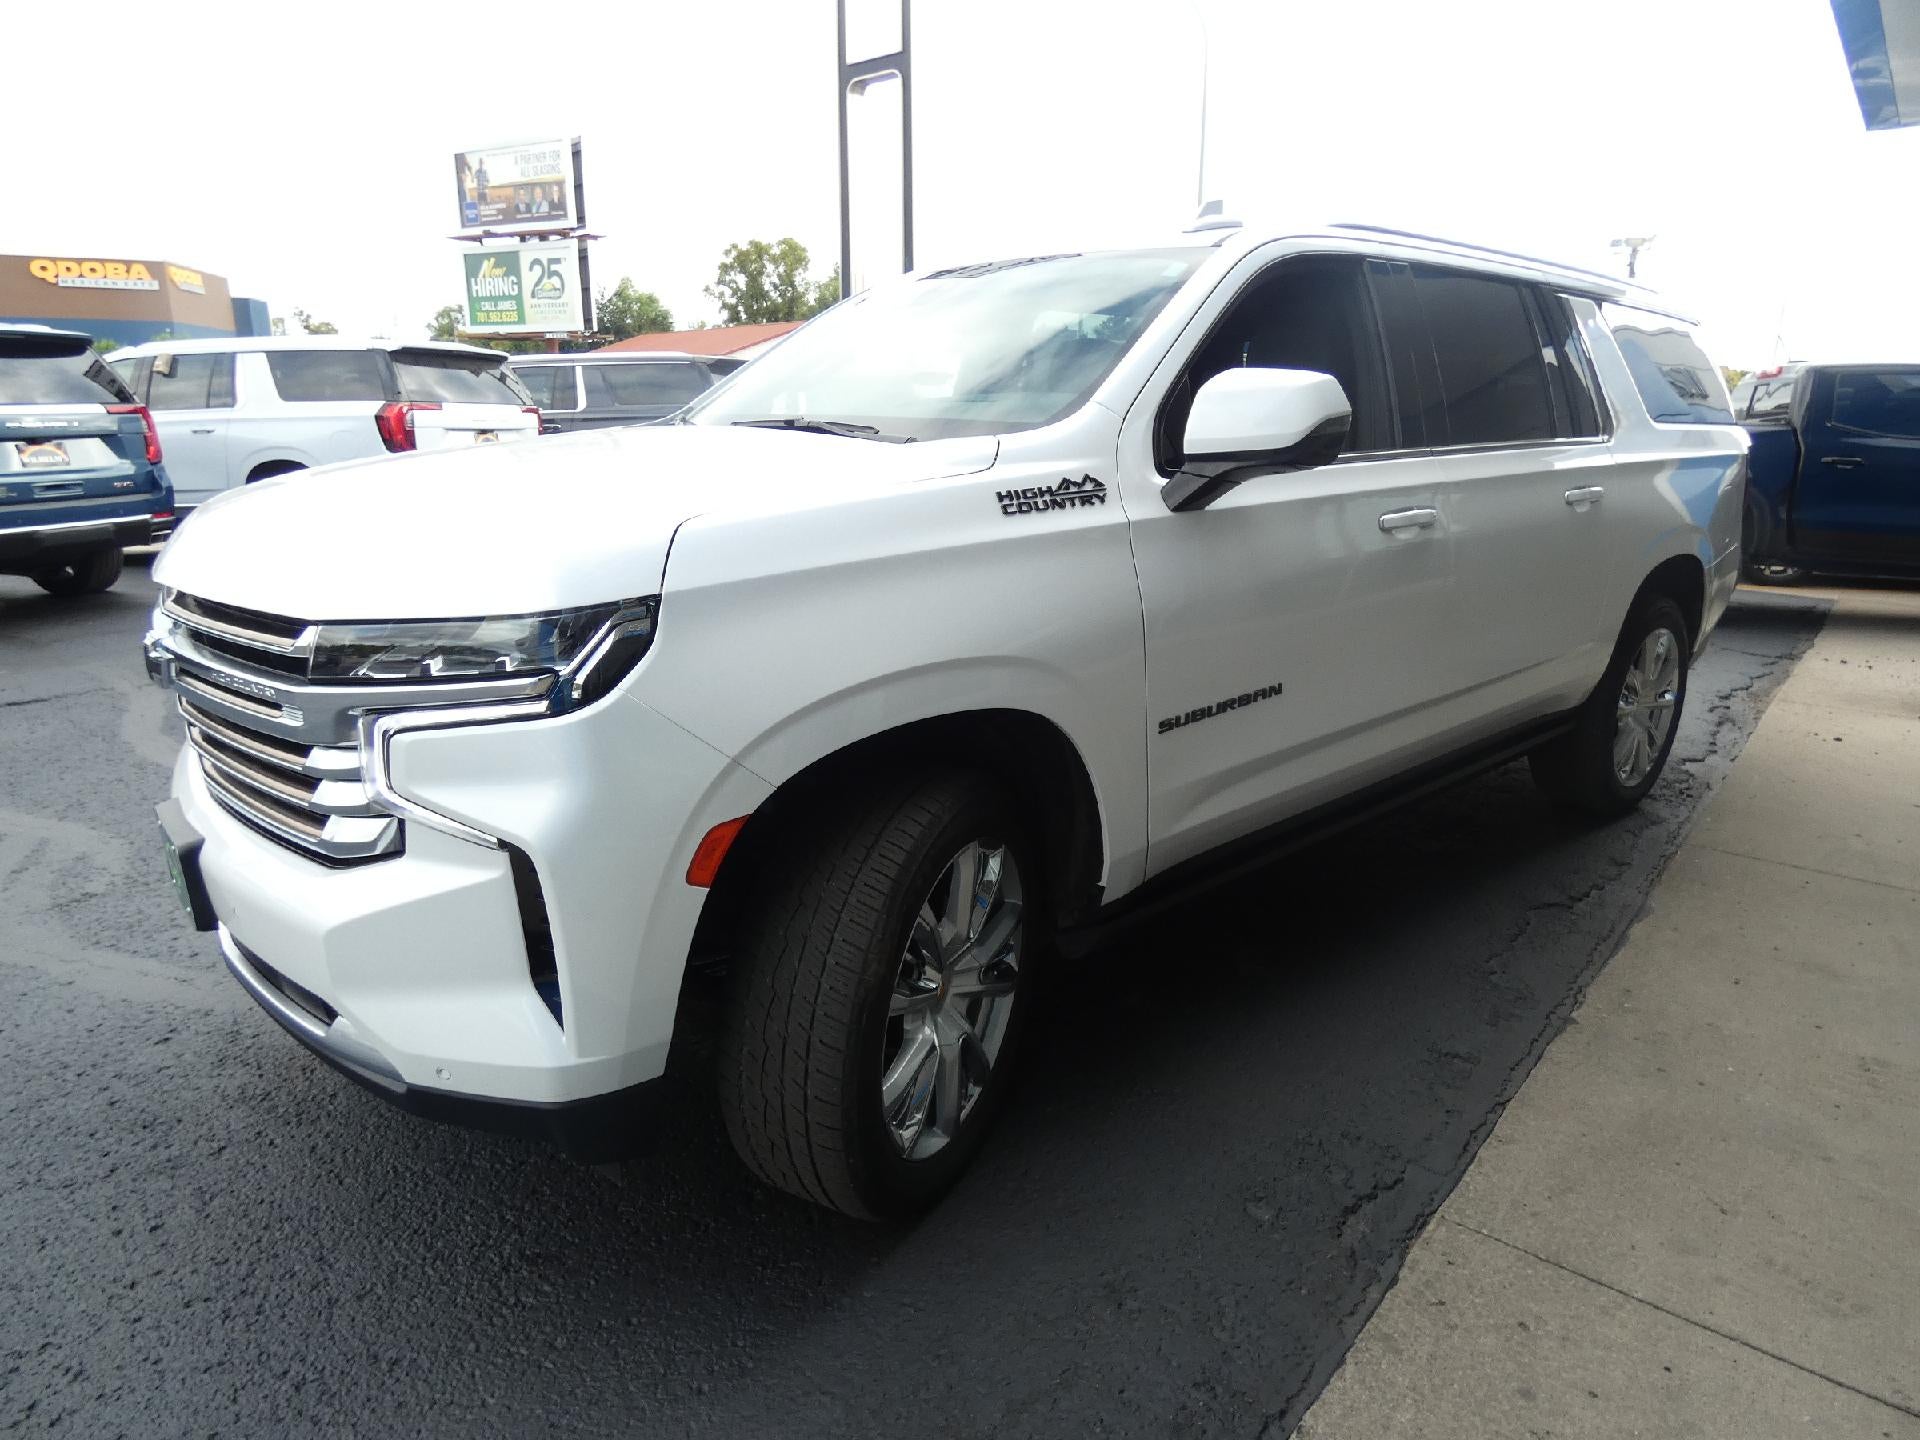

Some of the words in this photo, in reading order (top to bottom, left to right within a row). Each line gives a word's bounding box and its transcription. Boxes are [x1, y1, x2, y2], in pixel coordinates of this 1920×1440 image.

[548, 149, 562, 162] FOR
[29, 258, 152, 283] QDOBA
[61, 279, 119, 287] MEXICAN
[472, 276, 519, 297] HIRING
[995, 485, 1054, 503] HIGH
[1000, 492, 1107, 515] COUNTRY
[1158, 683, 1283, 735] SUBURBAN
